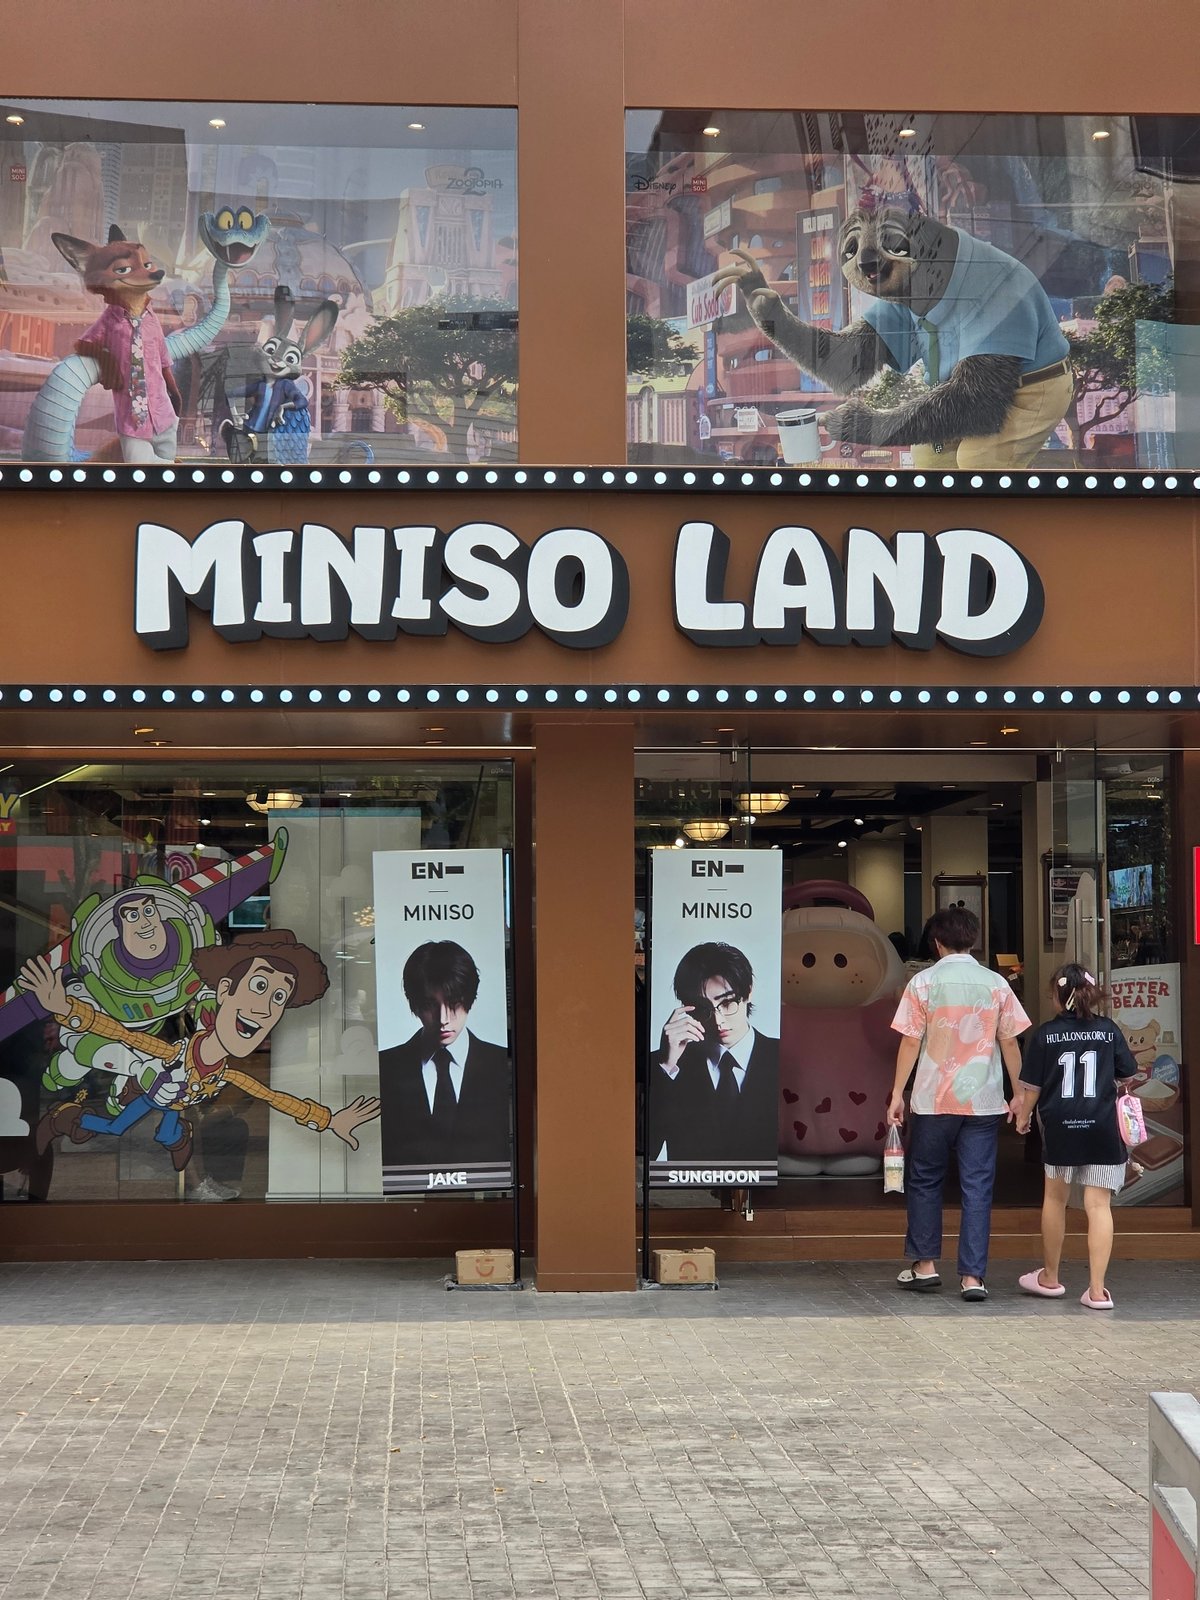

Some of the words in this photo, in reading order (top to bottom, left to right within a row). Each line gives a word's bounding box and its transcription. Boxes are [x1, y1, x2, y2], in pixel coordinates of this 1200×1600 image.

[135, 519, 620, 638] MINISO
[674, 521, 1035, 643] LAND
[404, 903, 474, 921] MINISO
[682, 902, 752, 919] MINISO
[1111, 981, 1170, 997] UTTER
[1111, 995, 1159, 1009] BEAR
[1046, 1030, 1114, 1044] HULALONGKORN_U
[1058, 1050, 1097, 1098] 11
[427, 1171, 467, 1189] JAKE
[668, 1170, 760, 1183] SUNGHOON
